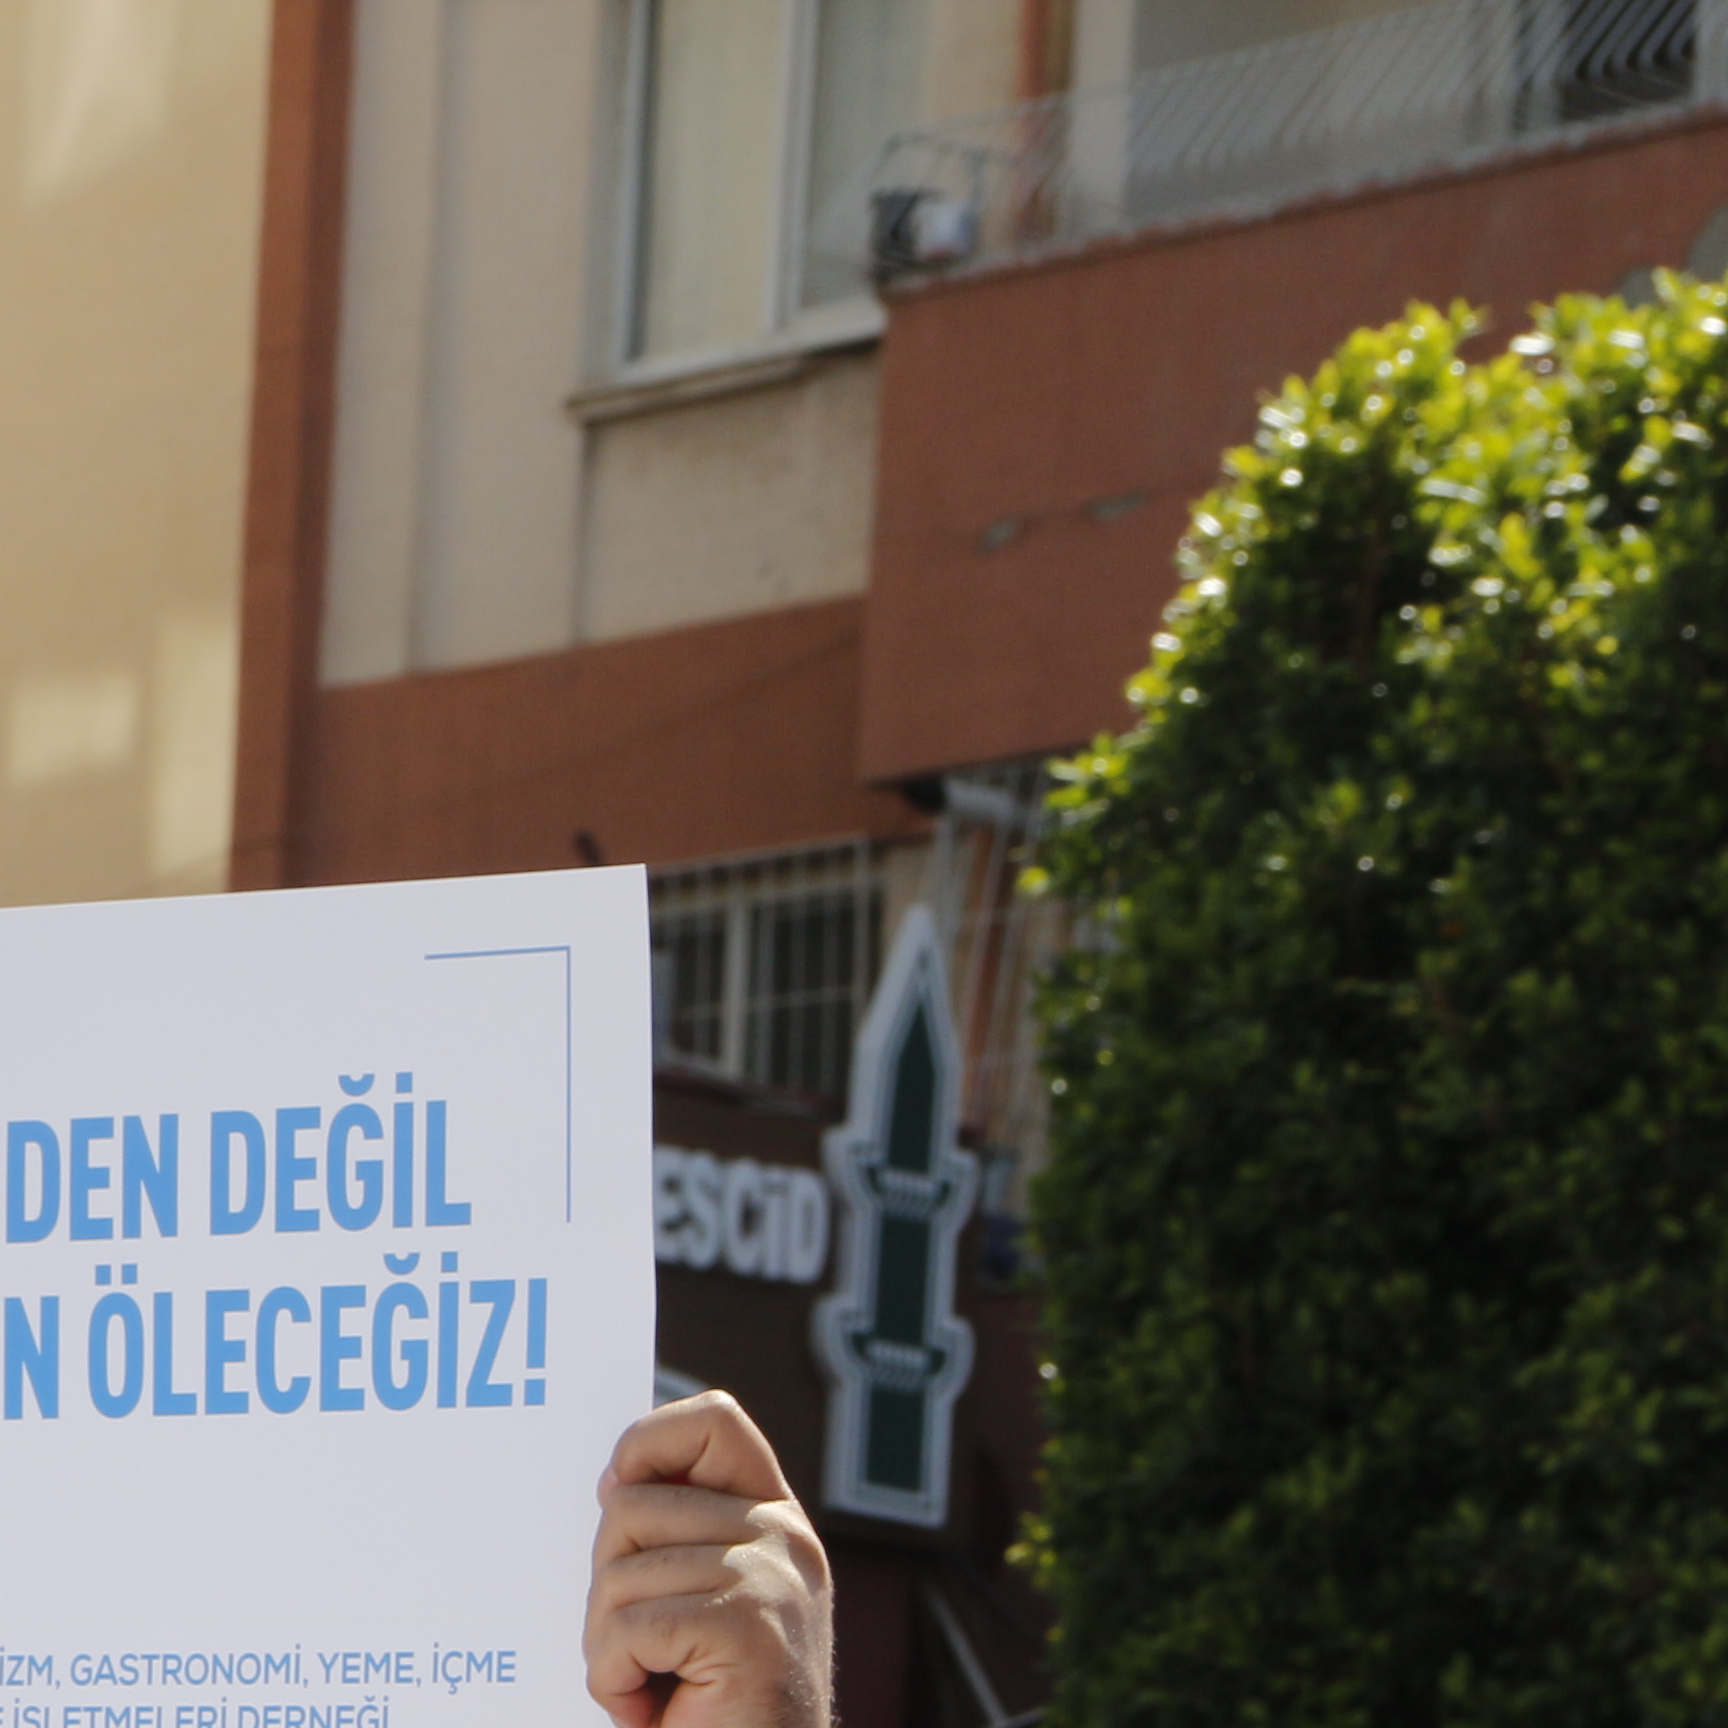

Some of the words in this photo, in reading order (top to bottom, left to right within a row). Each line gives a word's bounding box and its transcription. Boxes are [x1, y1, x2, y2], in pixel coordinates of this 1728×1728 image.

[211, 1072, 471, 1234] DEĞİL
[89, 1252, 546, 1417] ÖLECEĞİZ!
[69, 1643, 310, 1689] GASTRONOMİ,
[316, 1651, 423, 1688] YEME,
[431, 1641, 517, 1695] İÇME
